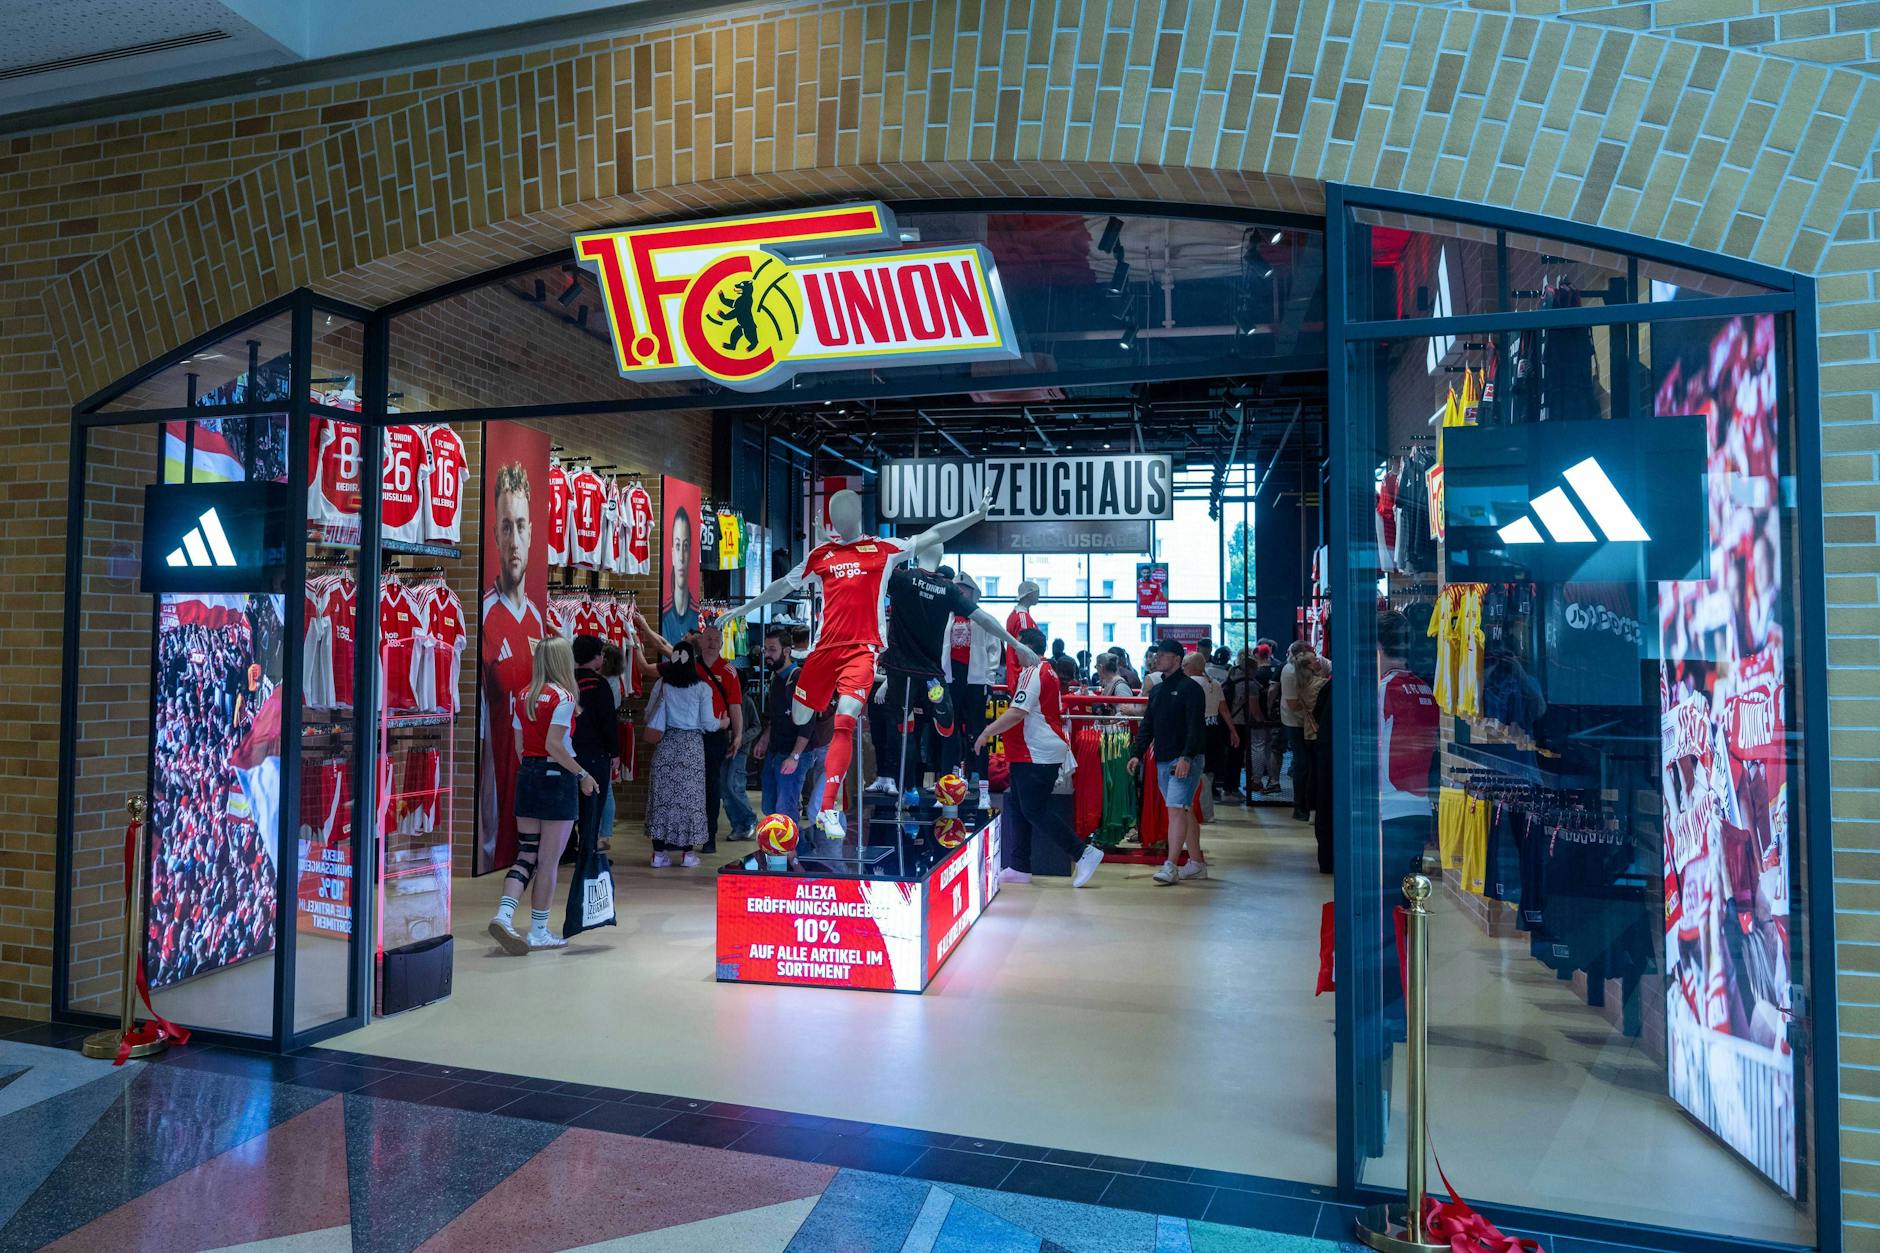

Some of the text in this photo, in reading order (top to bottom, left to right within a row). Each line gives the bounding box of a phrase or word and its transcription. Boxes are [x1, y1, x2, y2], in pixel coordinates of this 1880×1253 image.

[803, 260, 989, 347] UNION
[393, 432, 412, 443] UNION
[340, 436, 359, 480] 8
[382, 451, 412, 492] 26
[436, 456, 455, 498] 16
[583, 496, 592, 528] 4
[701, 525, 714, 545] 36
[724, 530, 734, 549] 14
[829, 562, 860, 573] home
[834, 569, 845, 579] to
[918, 579, 926, 590] FC
[926, 582, 947, 596] UNION
[795, 884, 837, 901] ALEXA
[793, 917, 841, 944] 10%
[749, 944, 883, 966] AUF ALLE ARTIKEL IM
[776, 961, 851, 980] SORTIMENT
